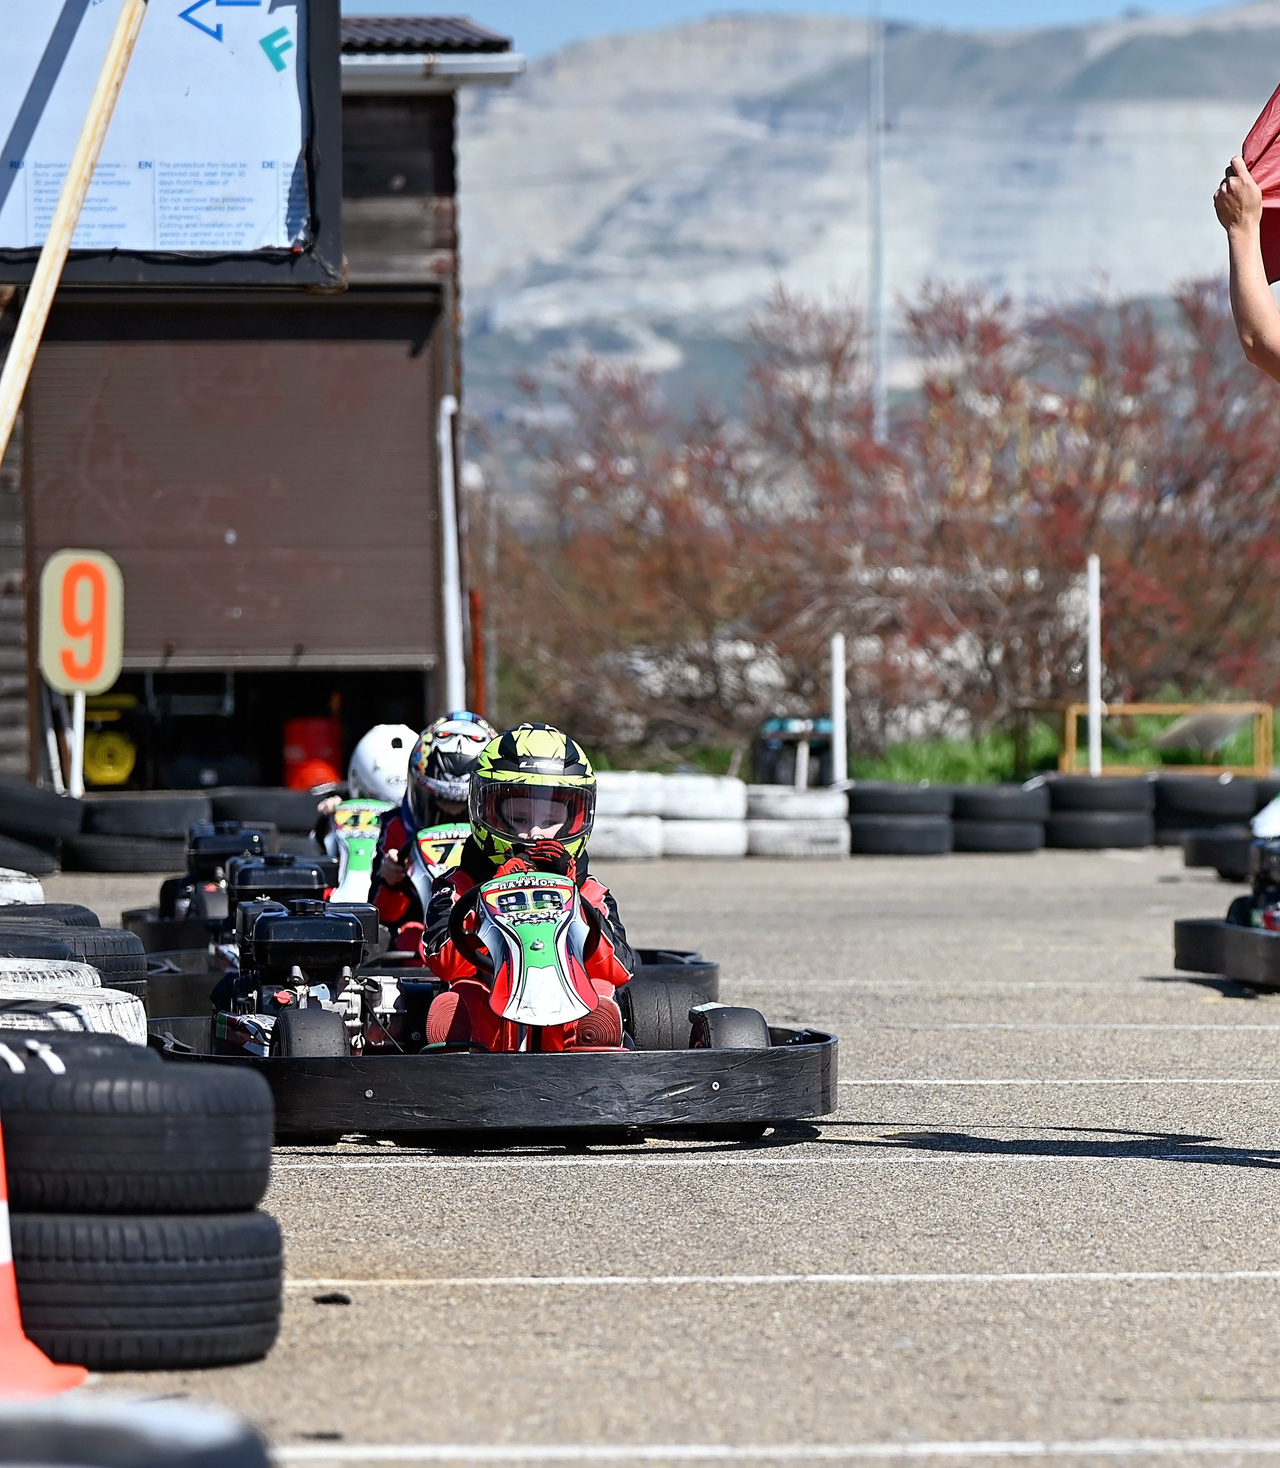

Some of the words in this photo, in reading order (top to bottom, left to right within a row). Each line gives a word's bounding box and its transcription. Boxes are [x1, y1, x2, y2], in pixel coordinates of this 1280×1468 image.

[259, 26, 294, 73] F
[138, 161, 152, 169] EN
[173, 162, 205, 170] protective
[262, 161, 276, 169] DE
[182, 205, 225, 213] temperatures
[60, 559, 107, 683] 9
[431, 843, 466, 864] 7
